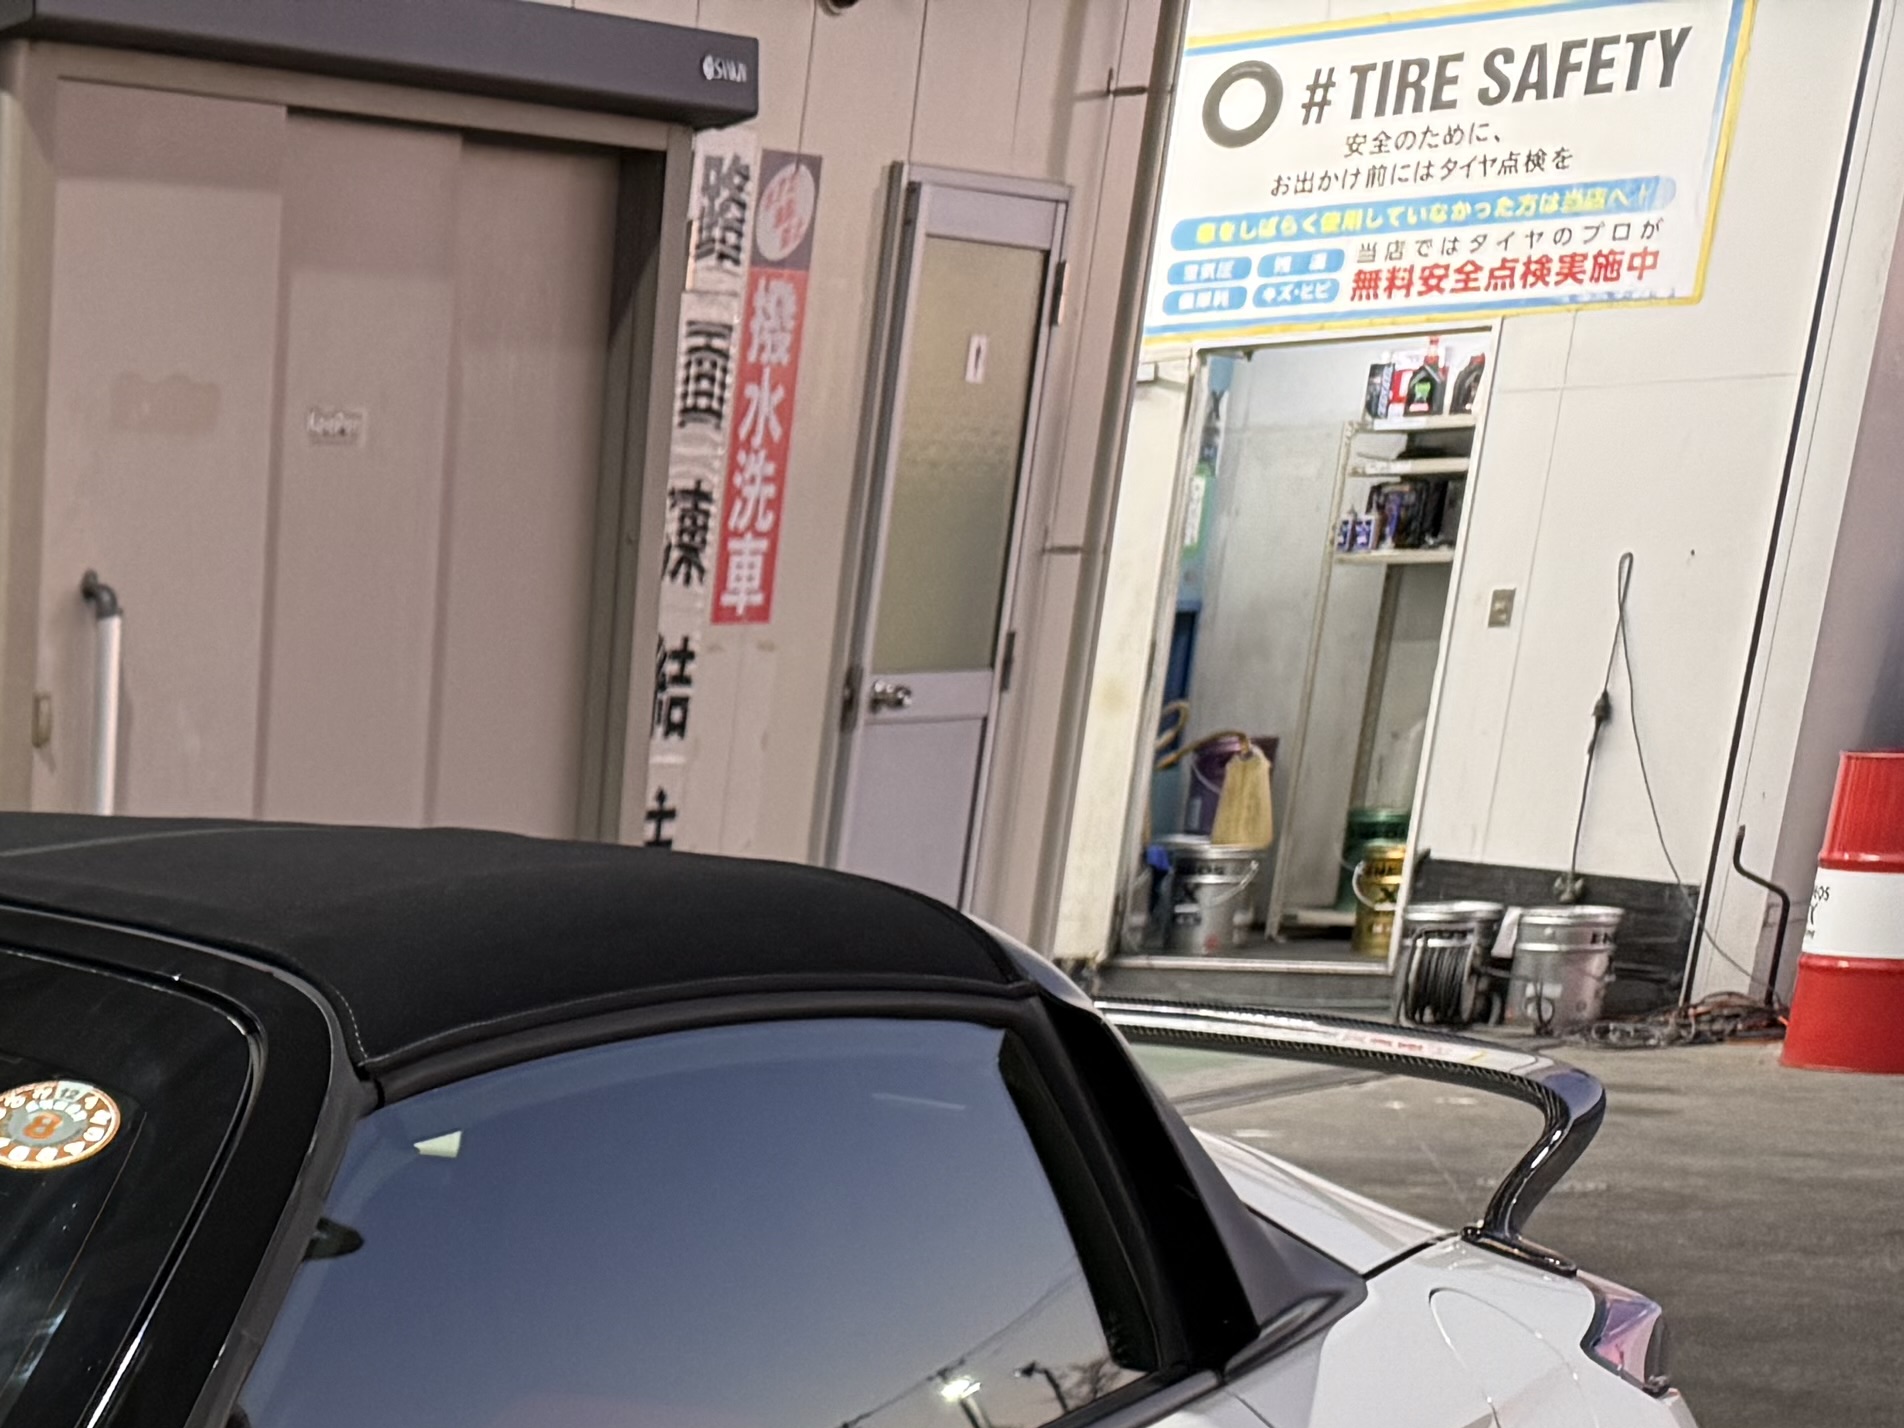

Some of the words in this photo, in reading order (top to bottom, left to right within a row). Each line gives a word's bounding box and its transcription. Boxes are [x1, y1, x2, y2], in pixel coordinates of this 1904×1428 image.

[1477, 26, 1693, 107] SAFETY
[1343, 121, 1503, 158] 安全のために、
[1271, 146, 1575, 197] お出かけ前にはタイヤ点検を
[1356, 216, 1666, 264] 当店ではタイヤのプロが
[1349, 245, 1662, 303] 無料安全点検実施中
[720, 274, 799, 618] 撥水洗車
[23, 1112, 63, 1140] 8
